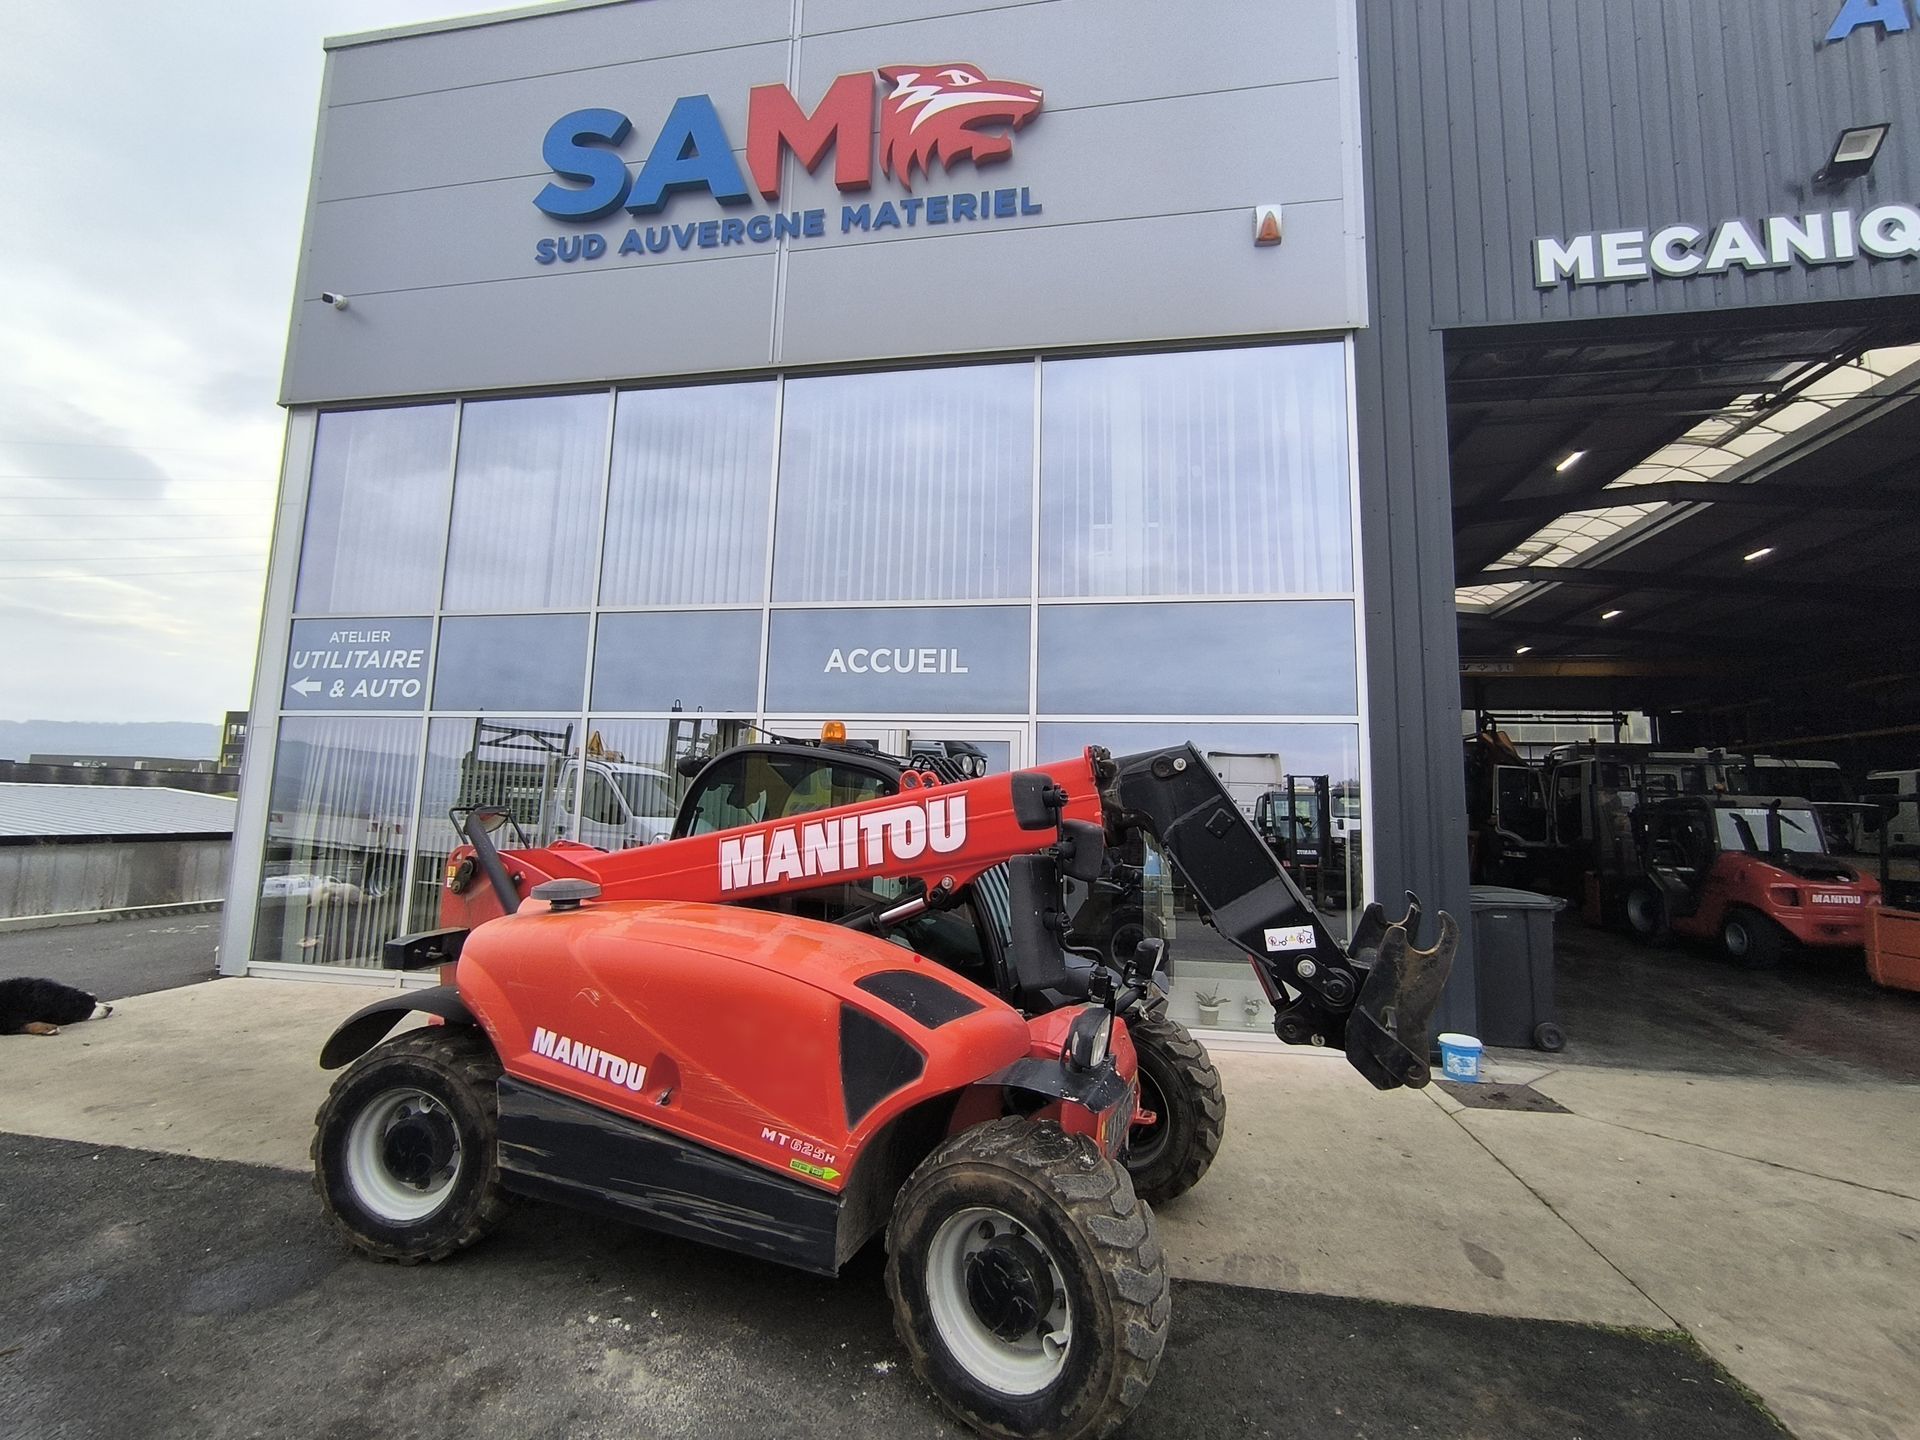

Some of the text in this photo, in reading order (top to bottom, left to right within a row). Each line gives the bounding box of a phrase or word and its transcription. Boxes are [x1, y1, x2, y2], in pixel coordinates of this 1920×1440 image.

[533, 70, 876, 223] SAM
[535, 186, 1043, 265] SUD AUVERGNE MATERIEL
[1536, 205, 1920, 284] MECANIQ
[328, 630, 391, 644] ATELIER
[292, 649, 425, 670] UTILITAIRE
[823, 648, 969, 674] ACCUEIL
[329, 678, 422, 698] & AUTO
[719, 792, 968, 892] MANITOU
[1811, 893, 1862, 905] MANITOU
[531, 1025, 648, 1092] MANITOU
[761, 1127, 791, 1146] MT
